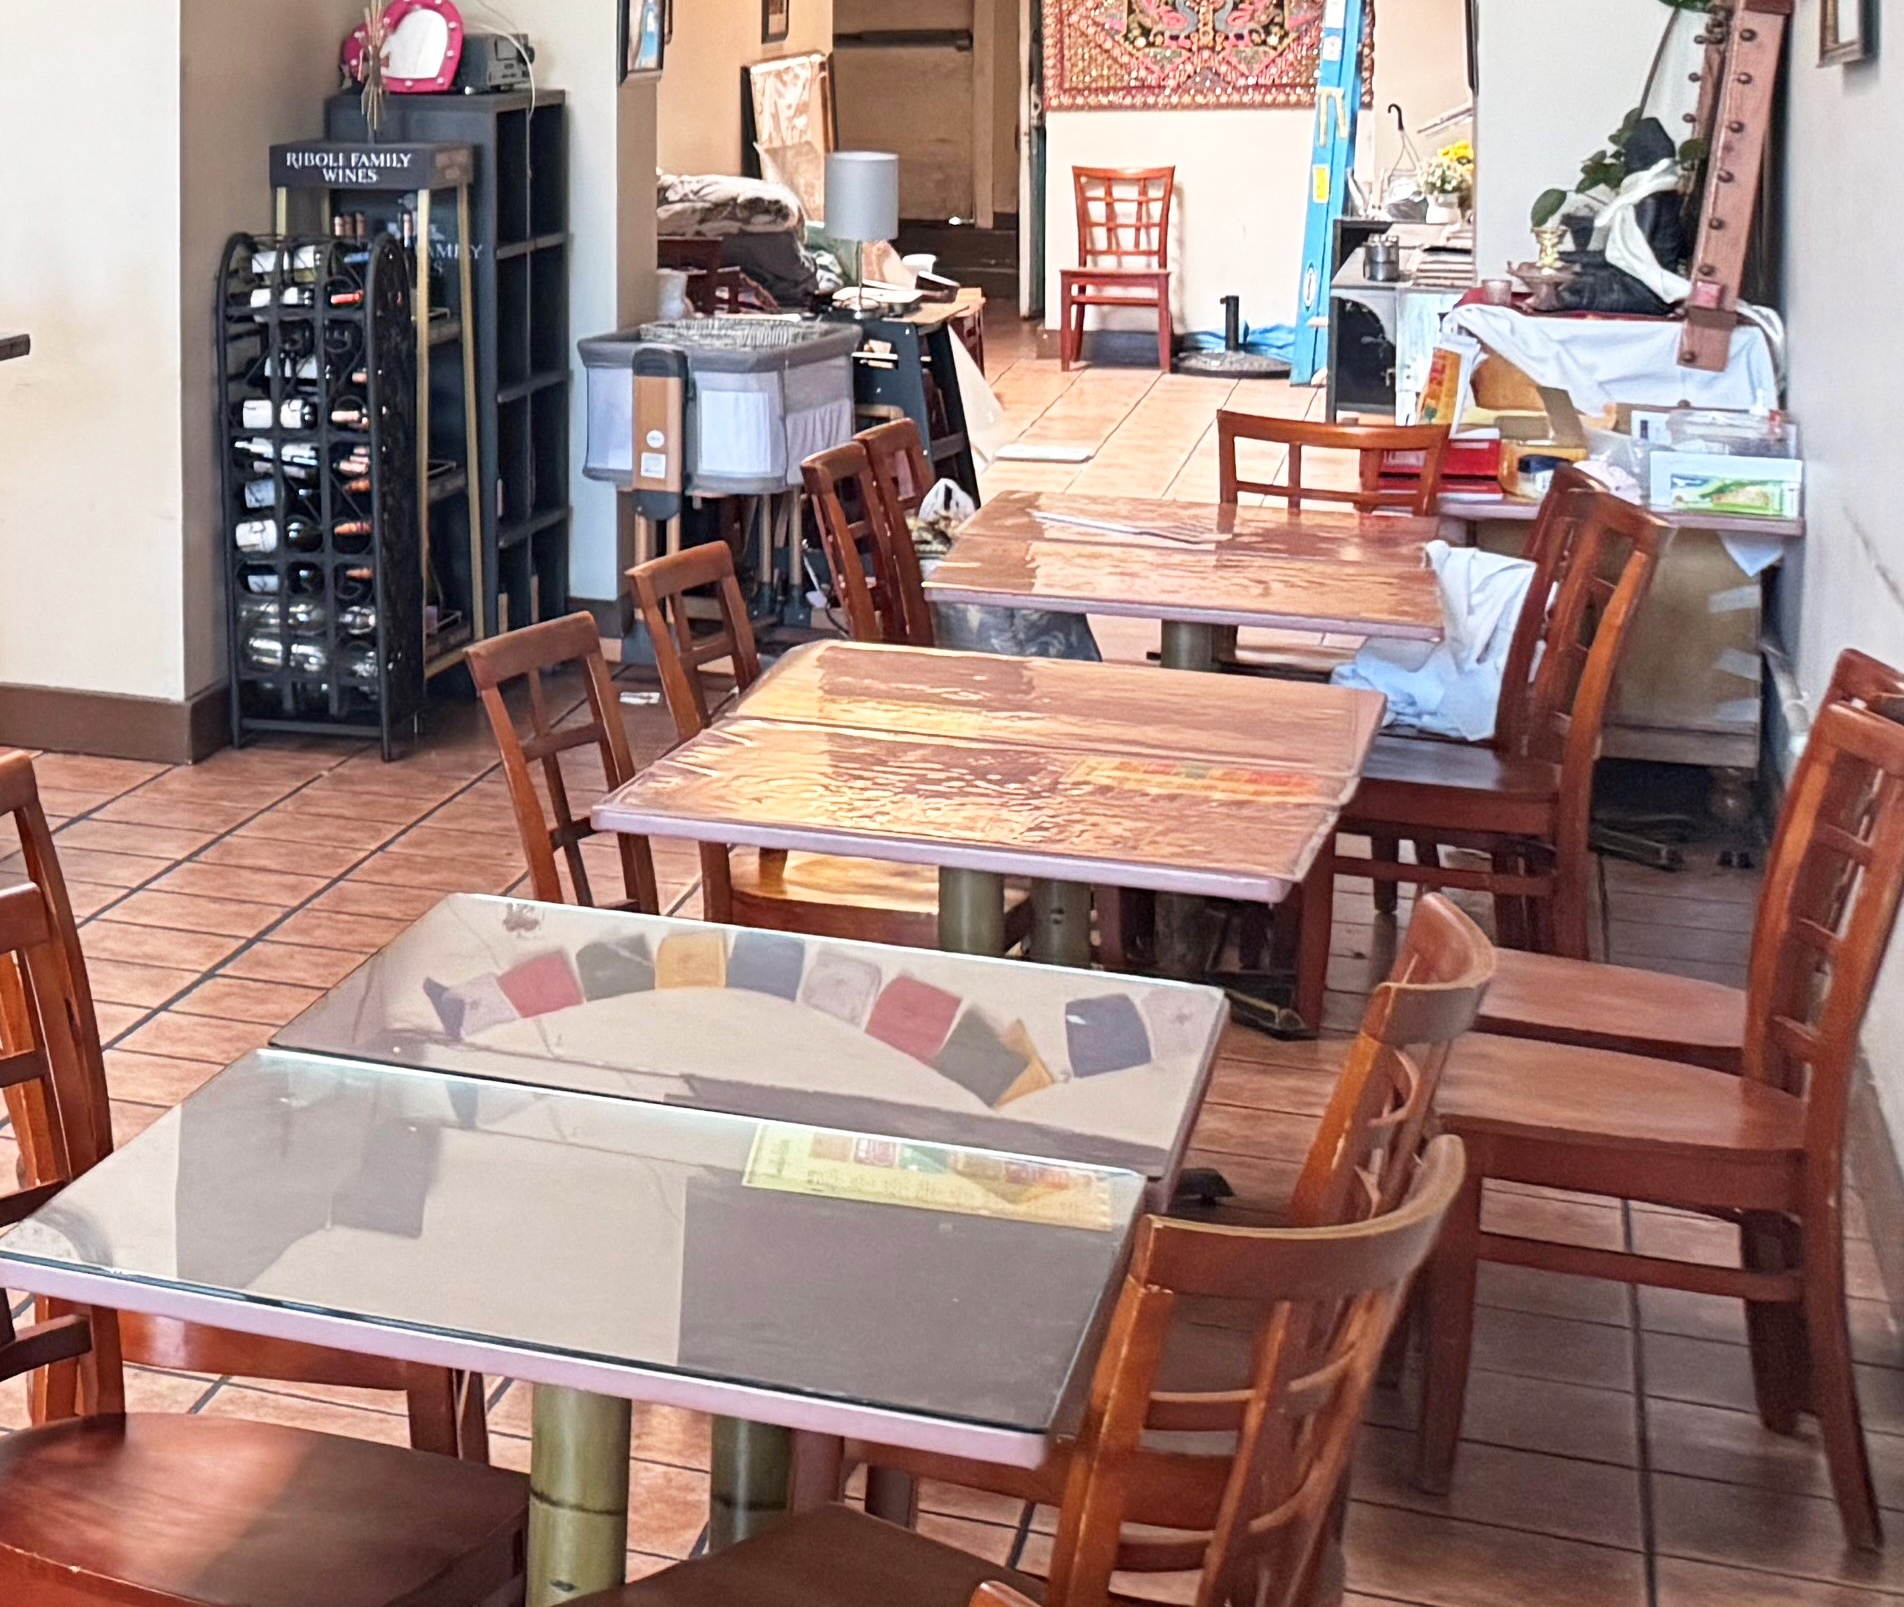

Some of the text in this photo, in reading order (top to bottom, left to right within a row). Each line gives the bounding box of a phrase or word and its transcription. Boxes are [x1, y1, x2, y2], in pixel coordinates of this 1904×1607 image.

[286, 152, 412, 169] RIBOLI FAMILY
[323, 168, 378, 183] WINES
